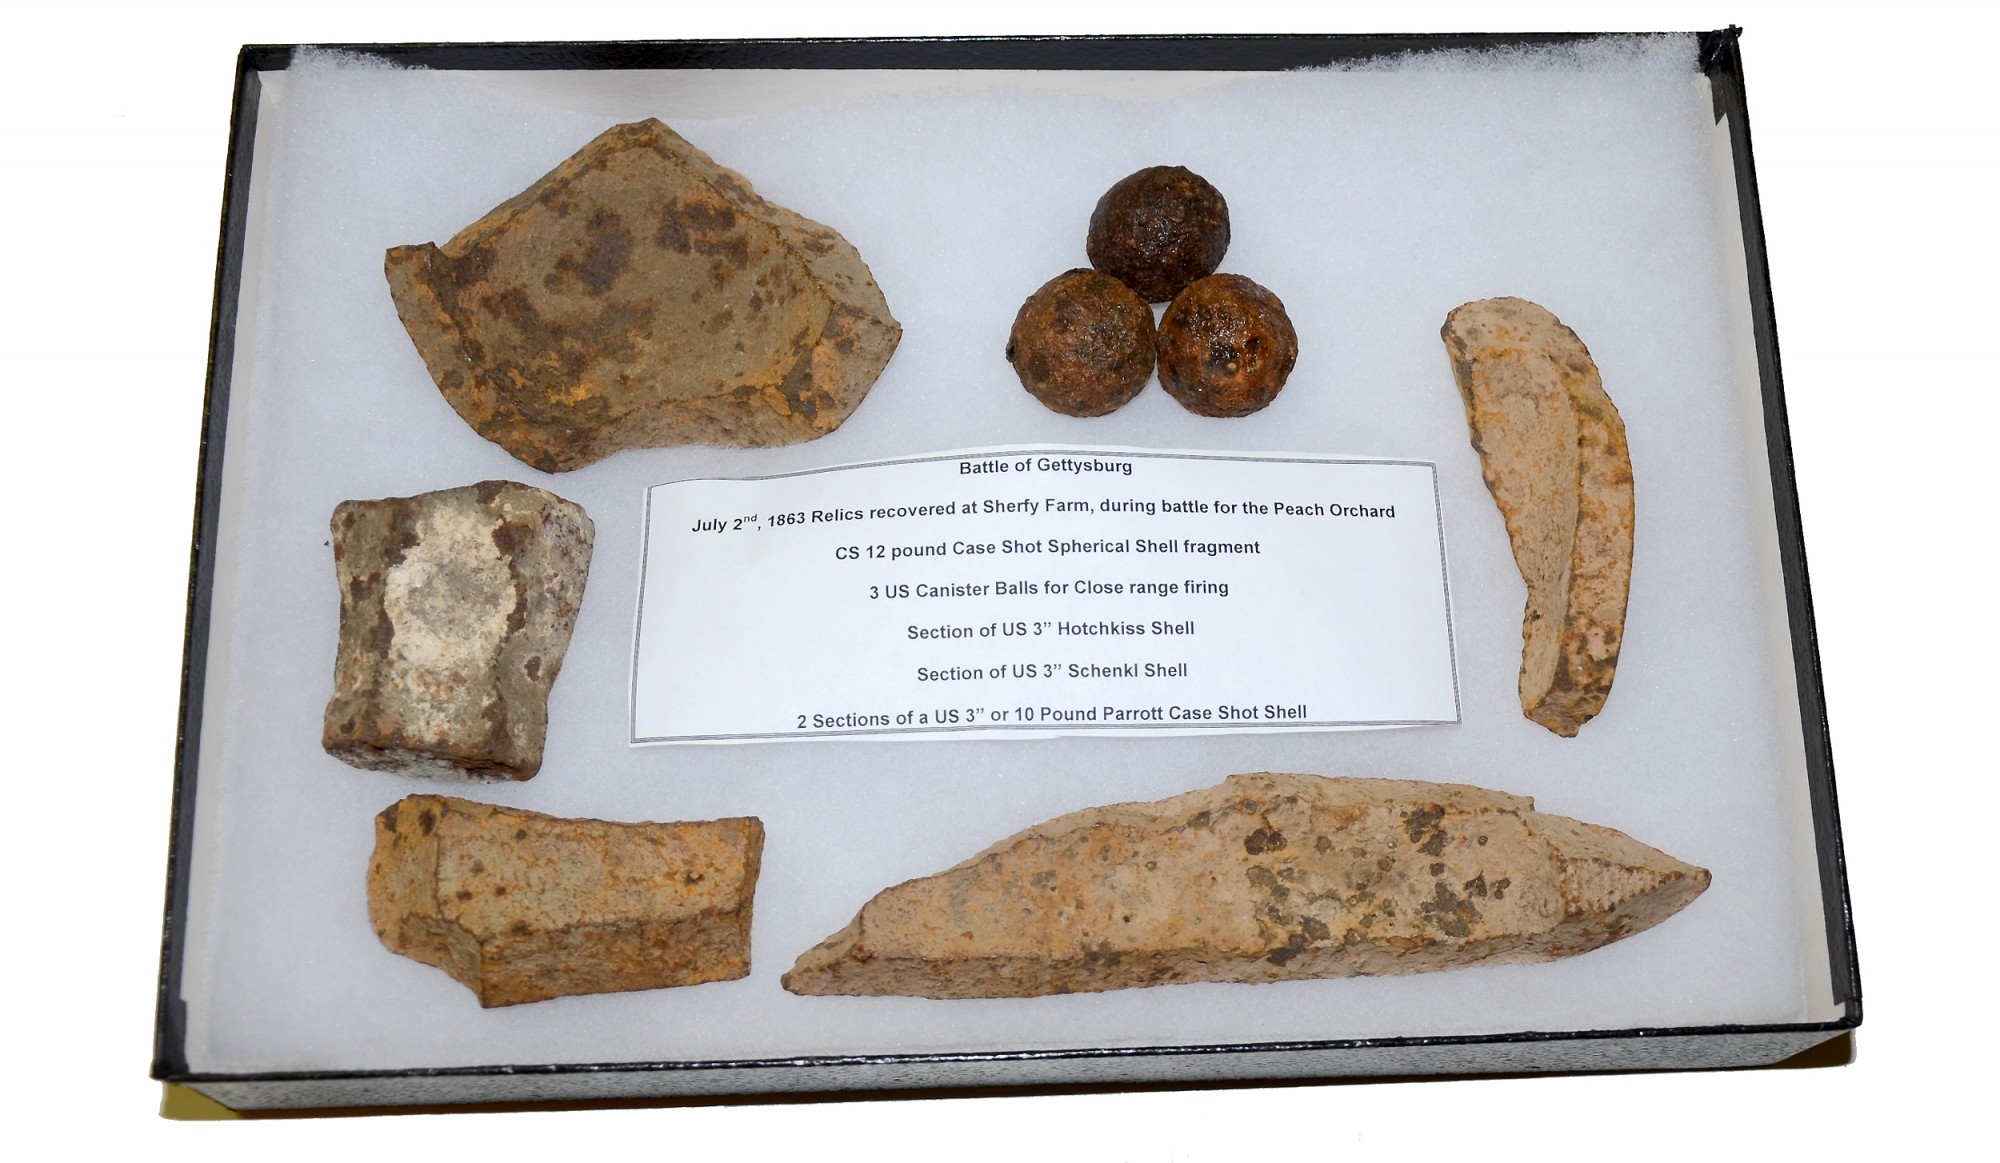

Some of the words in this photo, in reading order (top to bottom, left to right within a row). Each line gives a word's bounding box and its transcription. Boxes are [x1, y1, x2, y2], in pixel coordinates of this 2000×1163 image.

[960, 459, 1008, 474] Battle
[1014, 458, 1031, 471] of
[1037, 456, 1132, 476] Gettysburg
[691, 518, 727, 534] July
[767, 511, 805, 526] 1863
[811, 508, 863, 523] Relics
[870, 501, 955, 518] recovered
[961, 501, 977, 514] at
[983, 498, 1038, 516] Sherfy
[1045, 498, 1093, 515] Farm,
[1099, 497, 1155, 515] during
[1161, 498, 1208, 513] battle
[1213, 500, 1237, 514] for
[1239, 500, 1268, 514] the
[1273, 501, 1324, 515] Peach
[1329, 503, 1396, 518] Orchard
[835, 546, 859, 560] CS
[866, 544, 885, 558] 12
[891, 542, 945, 560] pound
[952, 541, 995, 555] Case
[1002, 539, 1042, 553] Shot
[1048, 539, 1129, 556] Spherical
[1135, 539, 1177, 553] Shell
[1183, 539, 1260, 557] fragment
[870, 585, 878, 599] 3
[885, 584, 909, 598] US
[916, 582, 989, 597] Canister
[995, 580, 1037, 594] Balls
[1043, 580, 1068, 594] for
[1074, 580, 1123, 594] Close
[1129, 583, 1178, 597] range
[1183, 579, 1229, 597] firing
[907, 624, 972, 639] Section
[979, 622, 996, 637] of
[1002, 622, 1026, 636] US
[1058, 621, 1145, 635] Hotchkiss
[1151, 620, 1194, 634] Shell
[917, 666, 982, 681] Section
[989, 664, 1006, 678] of
[1012, 663, 1036, 678] US
[1068, 663, 1137, 678] Schenkl
[1144, 662, 1186, 677] Shell
[797, 714, 806, 728] 2
[813, 712, 889, 728] Sections
[896, 710, 913, 725] of
[919, 713, 928, 724] a
[935, 709, 959, 724] US
[990, 710, 1008, 721] or
[1014, 707, 1033, 721] 10
[1040, 706, 1096, 720] Pound
[1103, 706, 1163, 720] Parrott
[1169, 705, 1211, 719] Case
[1218, 704, 1258, 719] Shot
[1264, 704, 1306, 718] Shell
